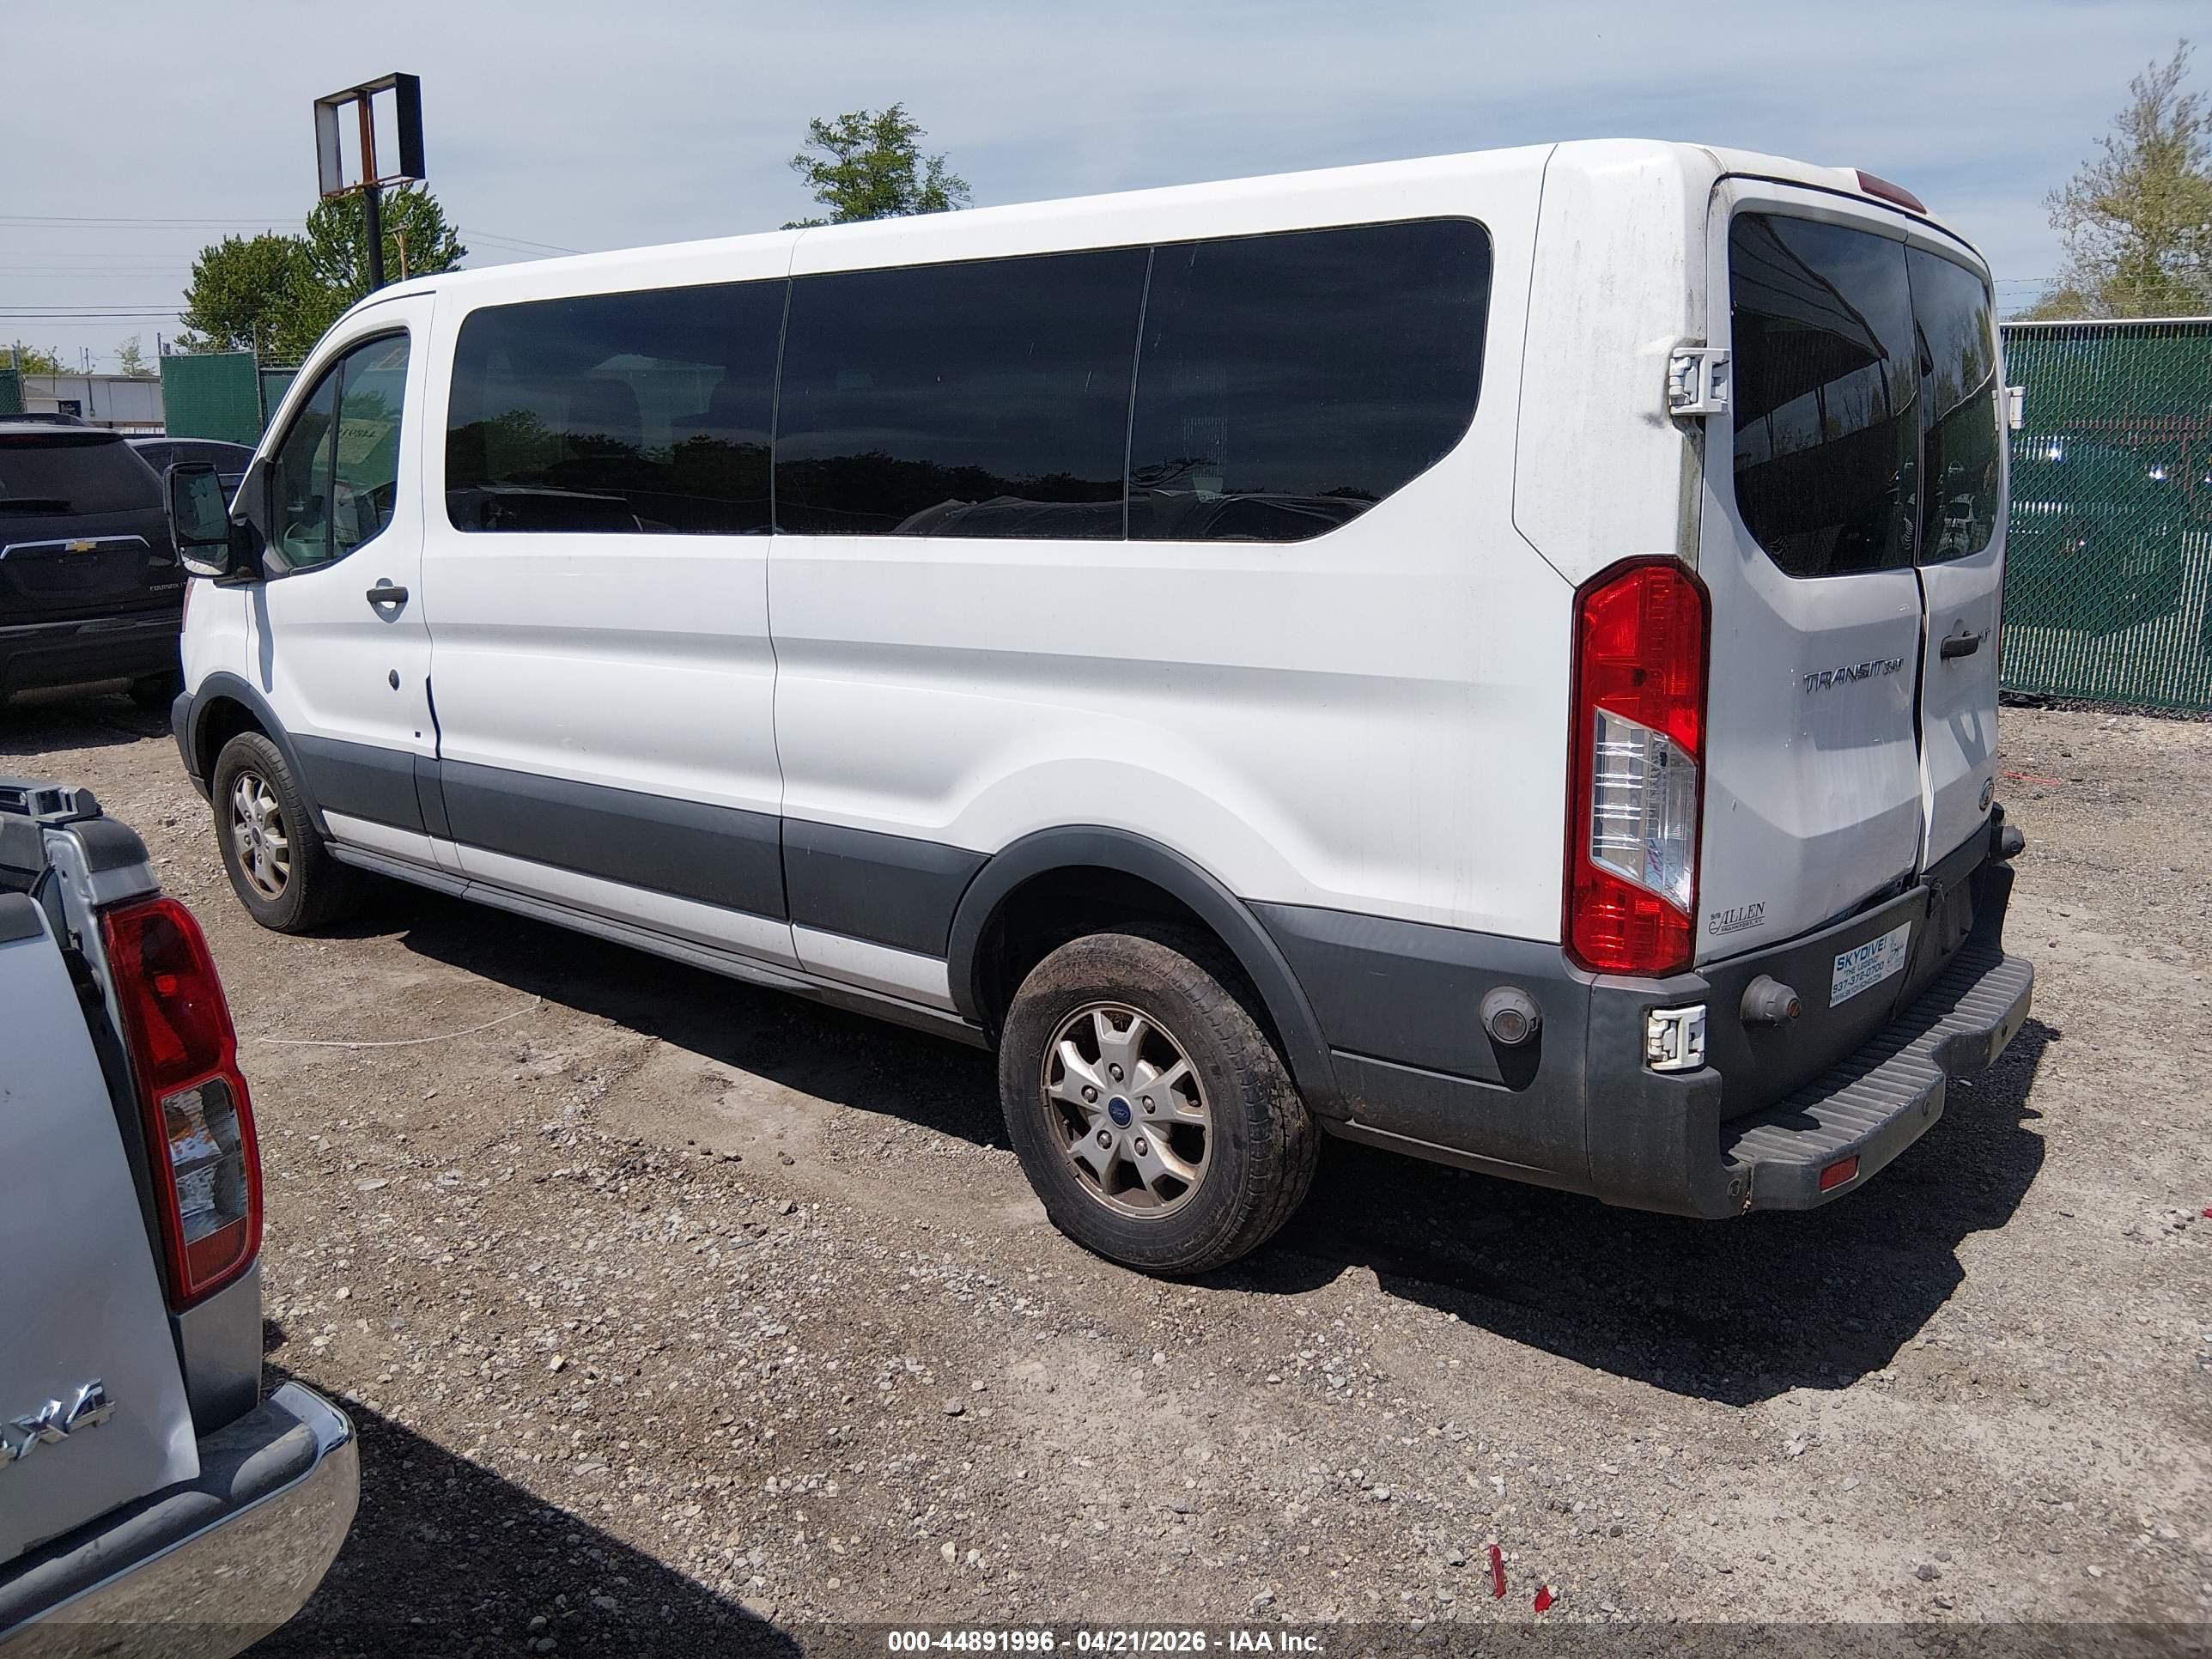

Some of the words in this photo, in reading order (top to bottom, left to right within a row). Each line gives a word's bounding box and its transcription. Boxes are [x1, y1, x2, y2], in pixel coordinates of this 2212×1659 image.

[1803, 659, 1885, 694] TRANSIT
[1709, 902, 1765, 934] ALLEN
[1836, 935, 1887, 972] SKYDIVE!
[1832, 961, 1885, 994] 937-372-0700
